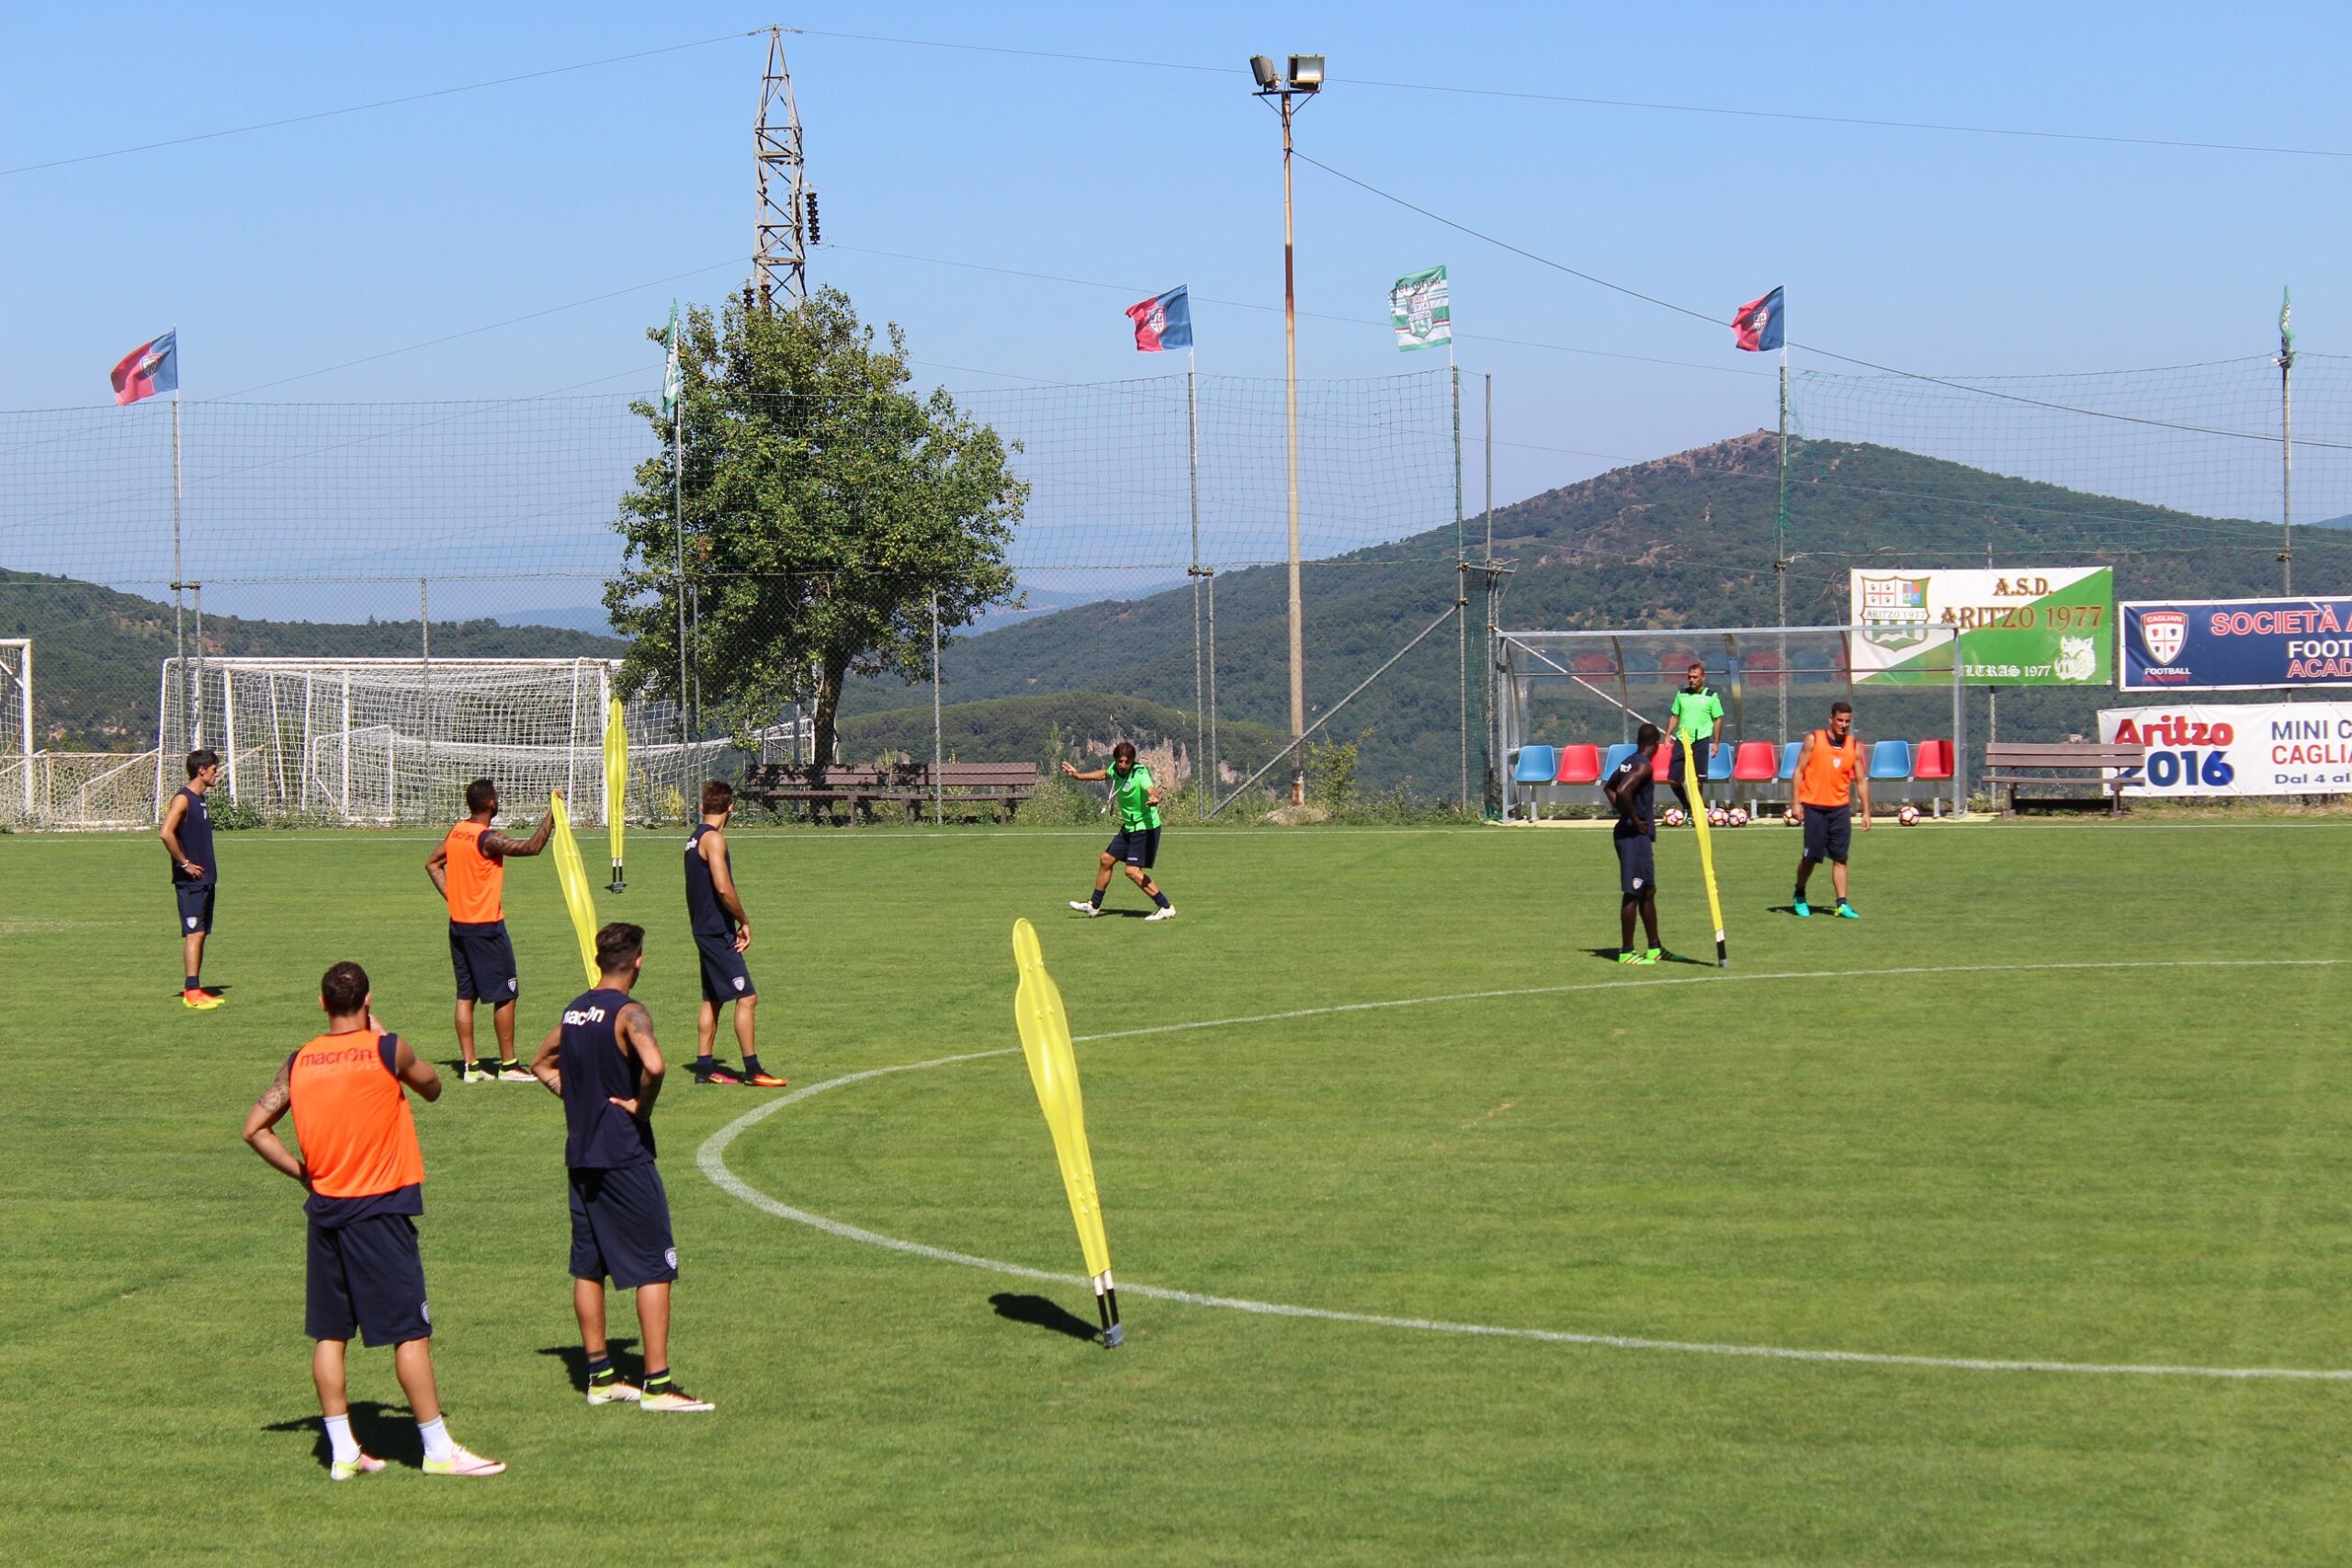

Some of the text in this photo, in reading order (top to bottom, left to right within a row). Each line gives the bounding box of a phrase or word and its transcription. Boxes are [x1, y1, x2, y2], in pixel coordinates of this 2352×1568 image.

[1993, 578, 2054, 596] A.S.D.
[1866, 610, 1926, 619] ARITZO 1977
[1940, 606, 2103, 631] ARITZO 1977
[2147, 615, 2183, 623] CAGLIARI
[2211, 605, 2341, 636] SOCIETÀ
[2024, 665, 2052, 677] 1977
[2144, 667, 2192, 675] FOOTBALL
[2114, 715, 2233, 747] Aritzo
[2272, 719, 2328, 740] MINI
[2271, 744, 2352, 765] CAGLI
[2275, 773, 2350, 784] Dal 4 al
